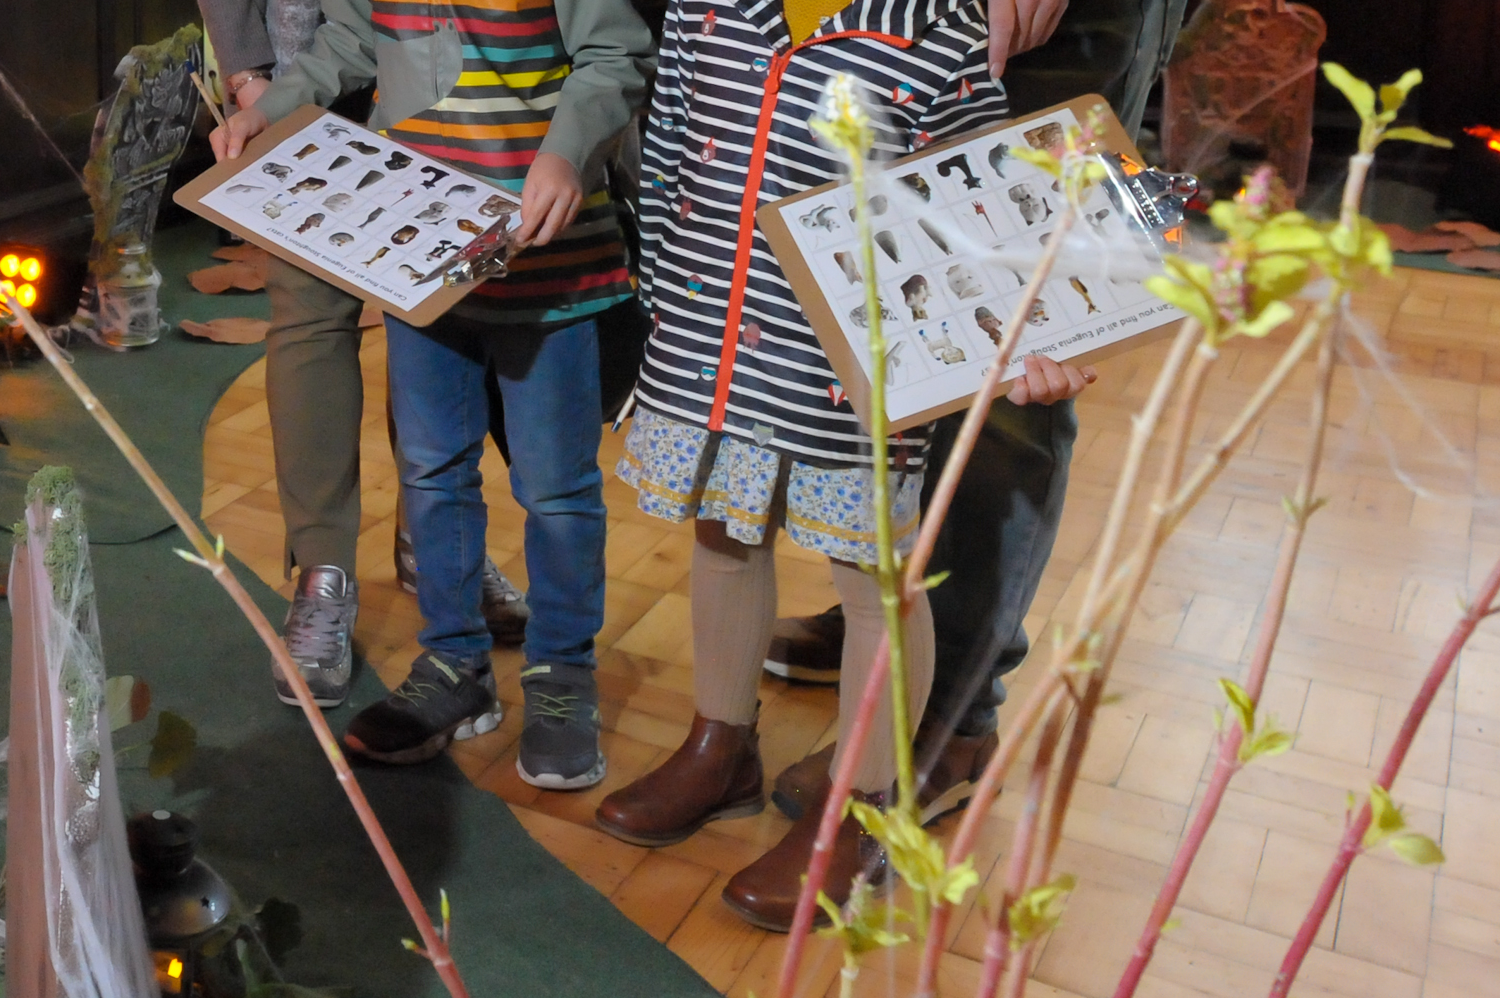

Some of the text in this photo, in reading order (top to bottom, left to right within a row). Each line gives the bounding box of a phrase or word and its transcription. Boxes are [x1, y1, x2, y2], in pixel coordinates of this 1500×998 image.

[266, 227, 408, 301] Can you find all of Eugenia Stoughton's cats?
[1138, 308, 1156, 318] you
[1108, 321, 1119, 331] all
[1120, 314, 1138, 326] find
[1096, 326, 1105, 337] of
[1058, 331, 1094, 347] Eugenia
[1006, 343, 1058, 368] Stougon'
